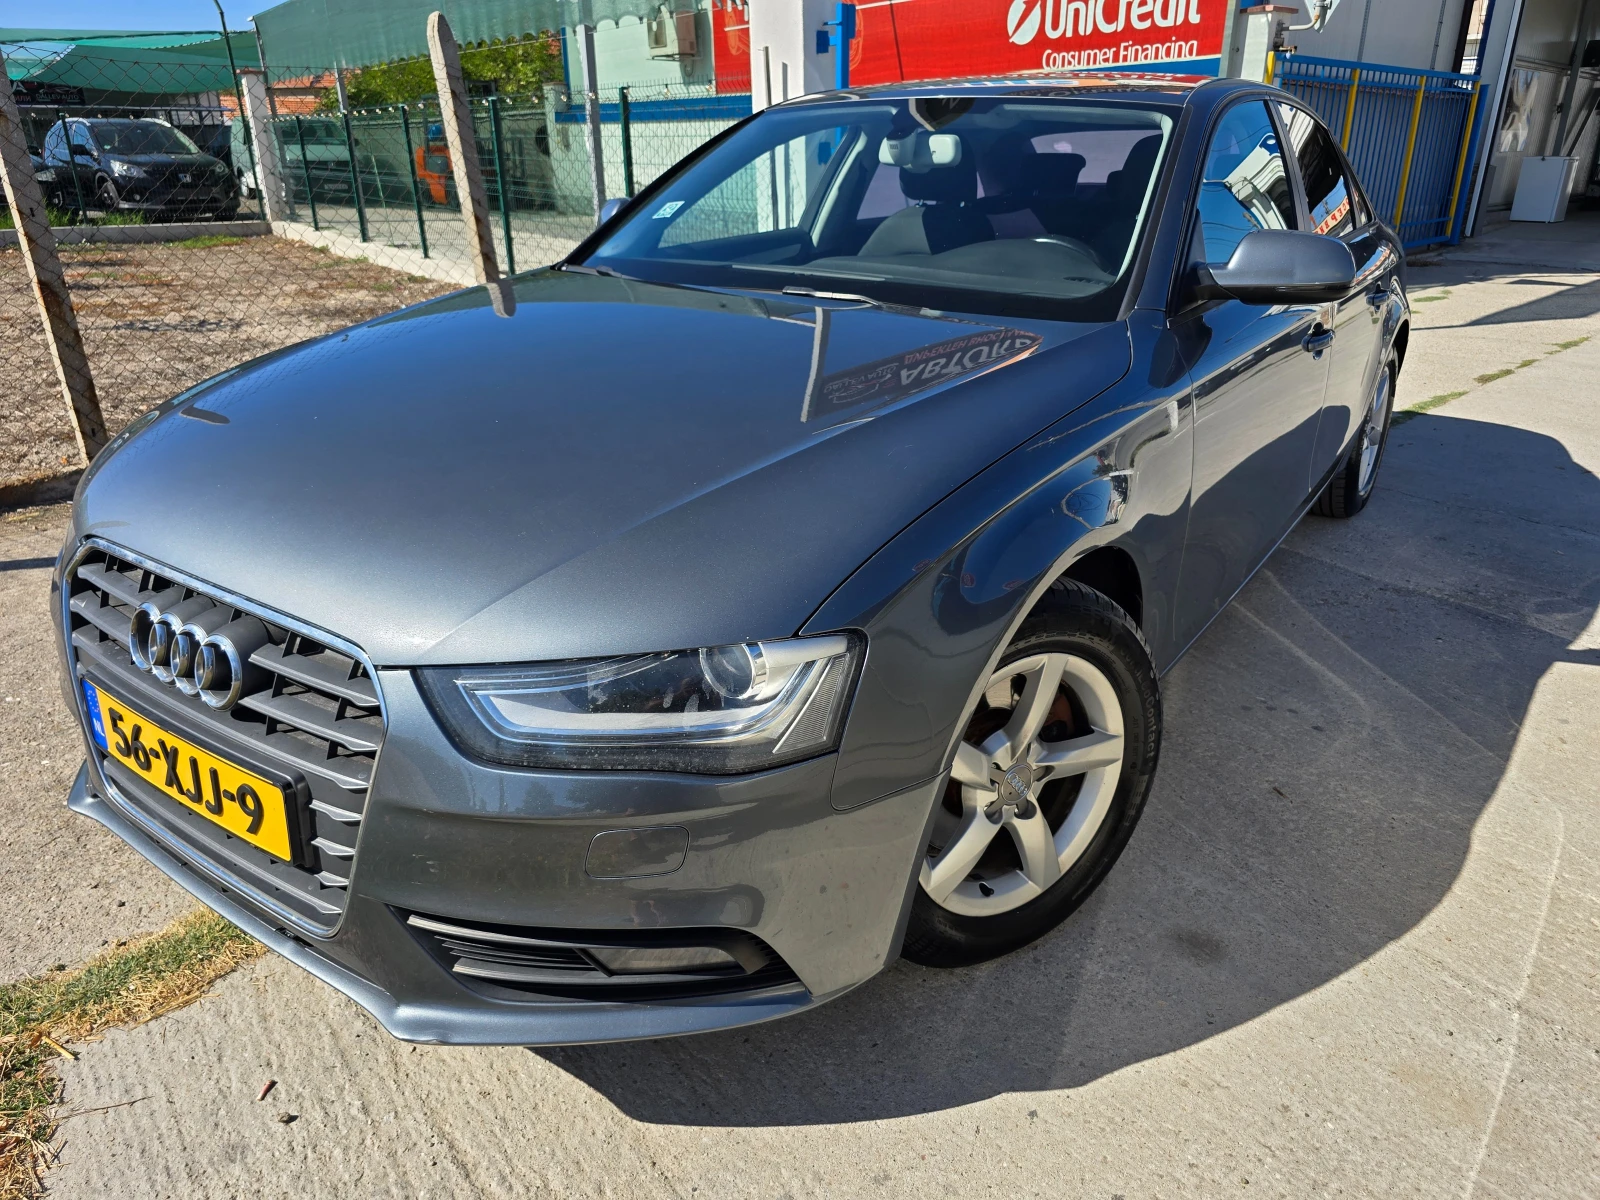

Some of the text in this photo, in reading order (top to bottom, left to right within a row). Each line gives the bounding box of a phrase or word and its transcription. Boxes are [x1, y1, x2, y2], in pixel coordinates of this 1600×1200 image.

[1044, 0, 1200, 39] UniCredit
[1042, 36, 1198, 70] Consumer Financing
[93, 717, 105, 737] NL
[108, 707, 264, 836] 56-XJJ-9
